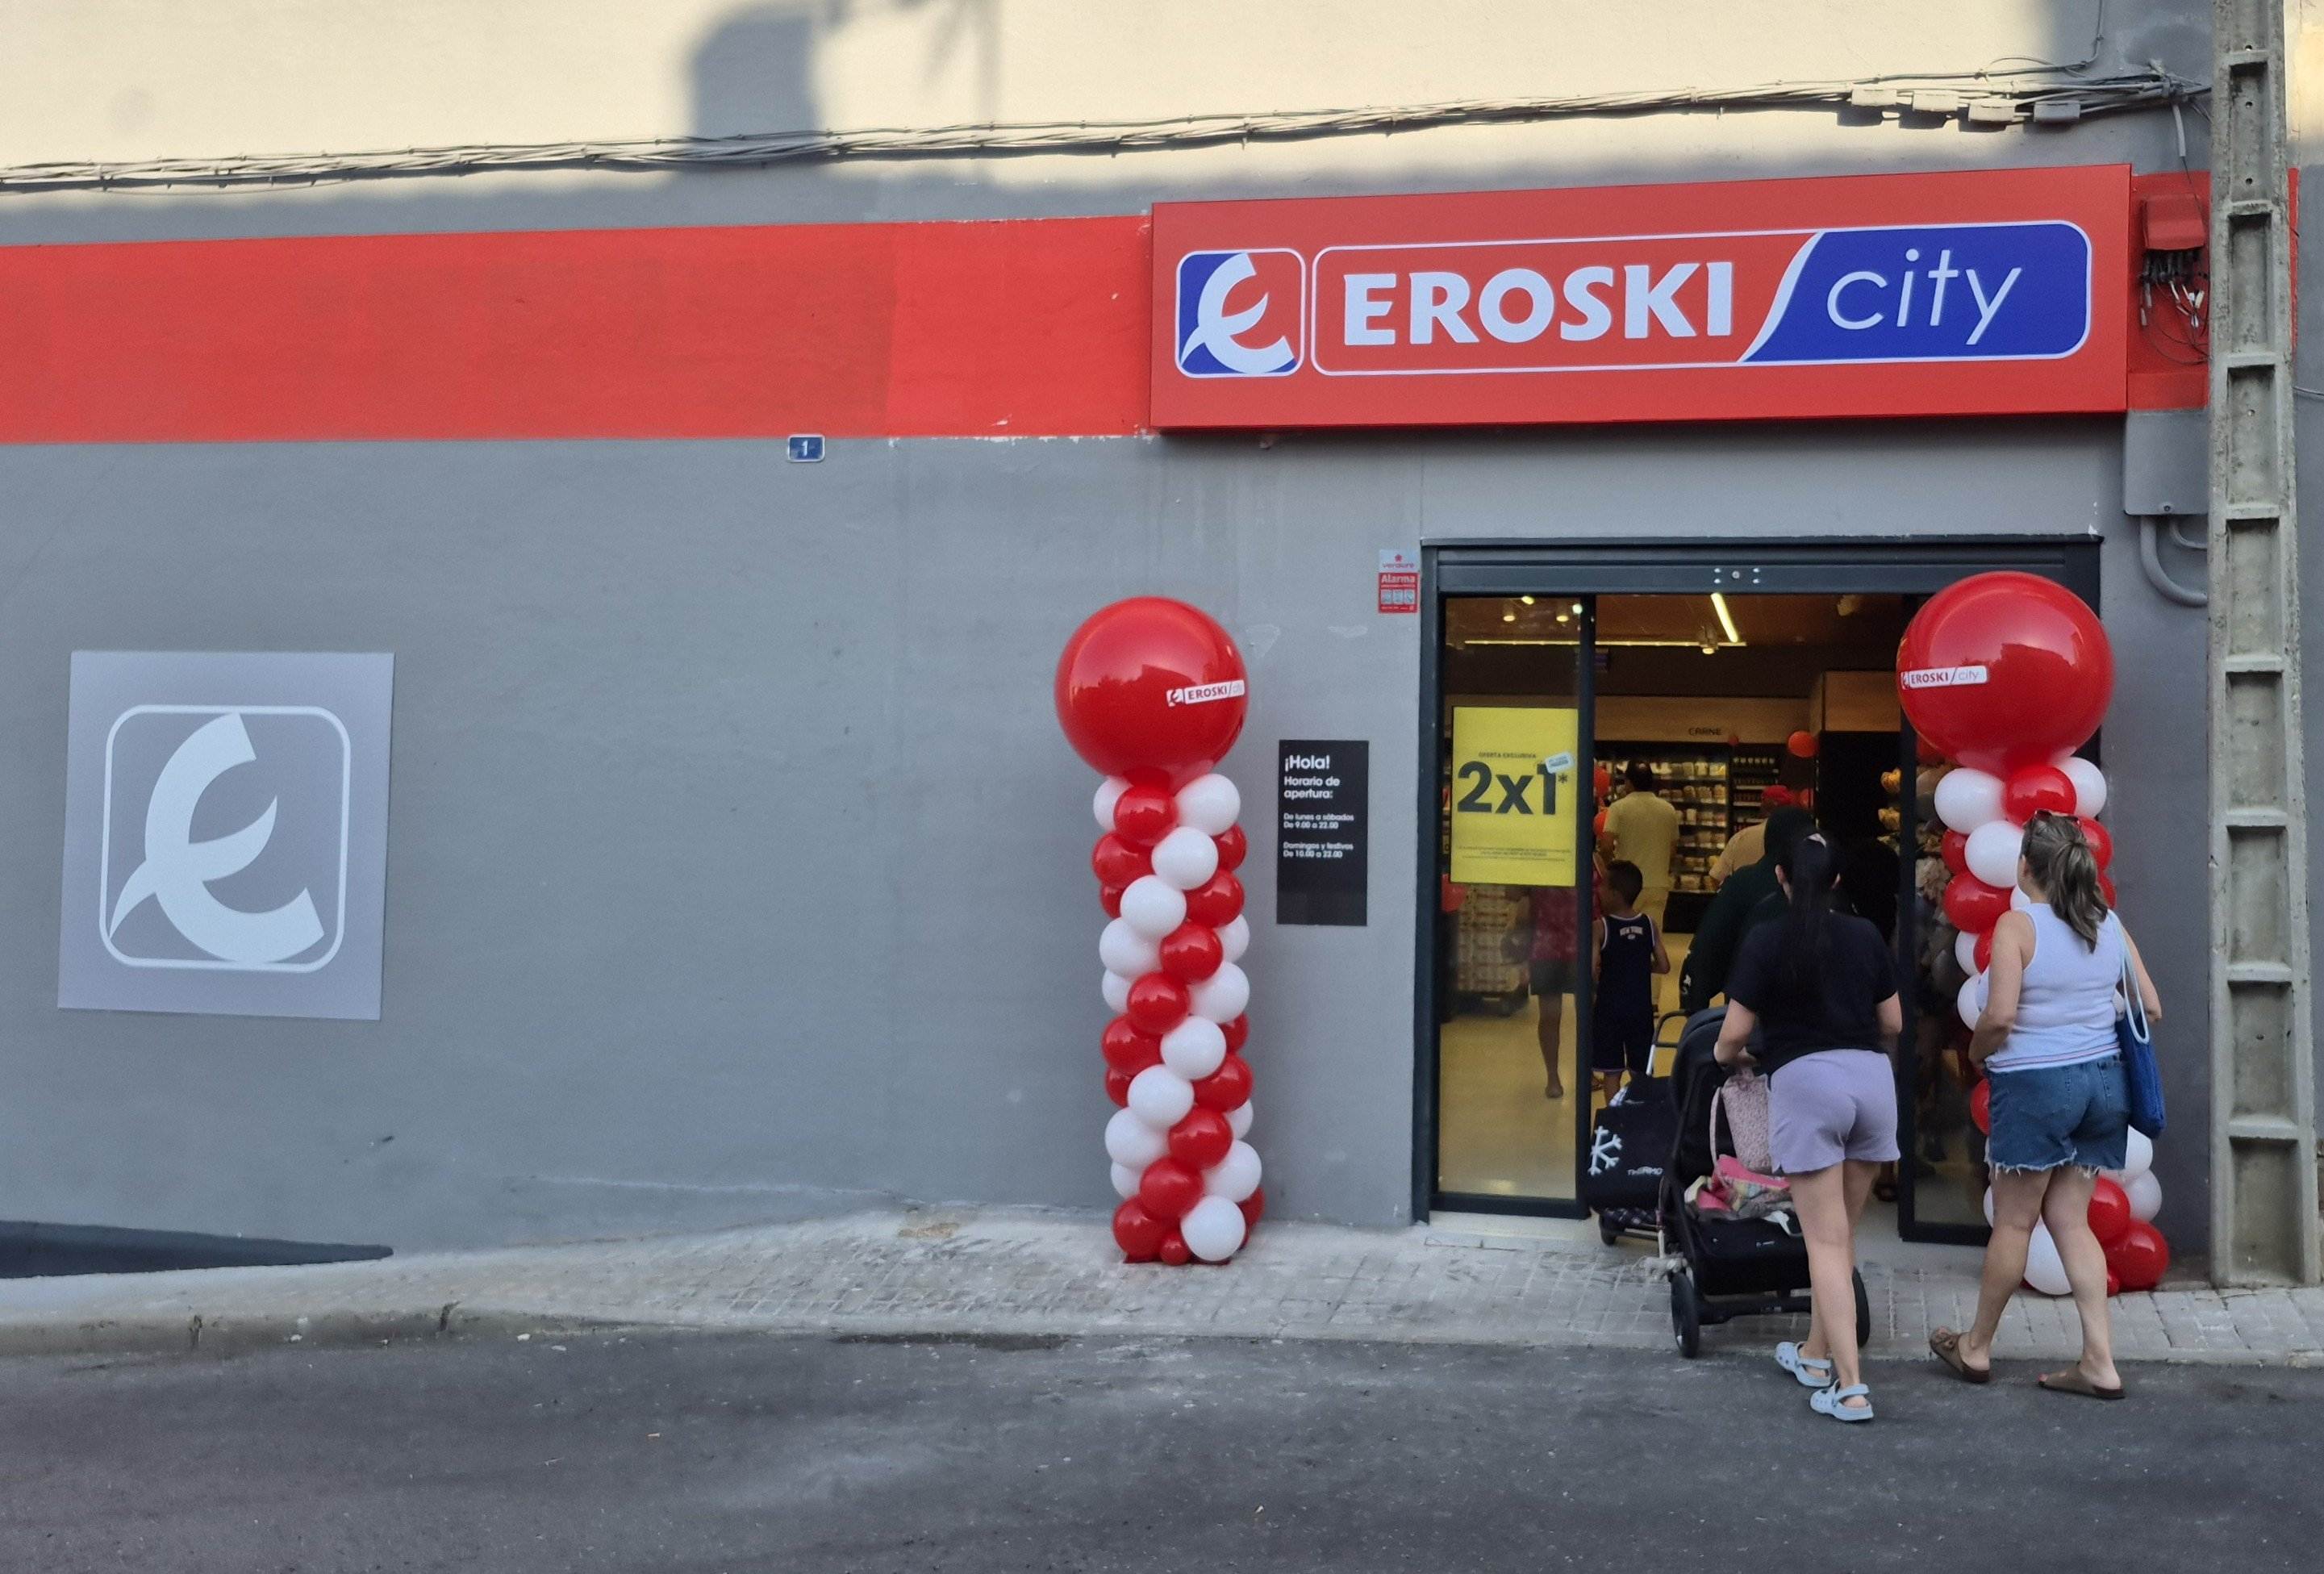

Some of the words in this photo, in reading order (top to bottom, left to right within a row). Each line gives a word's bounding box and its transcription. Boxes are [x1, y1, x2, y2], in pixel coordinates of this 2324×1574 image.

[1344, 261, 1733, 346] EROSKI
[1826, 248, 2022, 345] city
[801, 440, 808, 457] 1
[1910, 672, 1949, 685] EROSKI
[1959, 670, 1980, 682] city
[1188, 684, 1227, 700] EROSKI
[1285, 755, 1330, 772] ¡Hola!
[1283, 775, 1323, 787] Horario
[1325, 775, 1341, 787] de
[1283, 788, 1333, 800] apertura:
[1283, 812, 1294, 820] De
[1283, 850, 1294, 858] De
